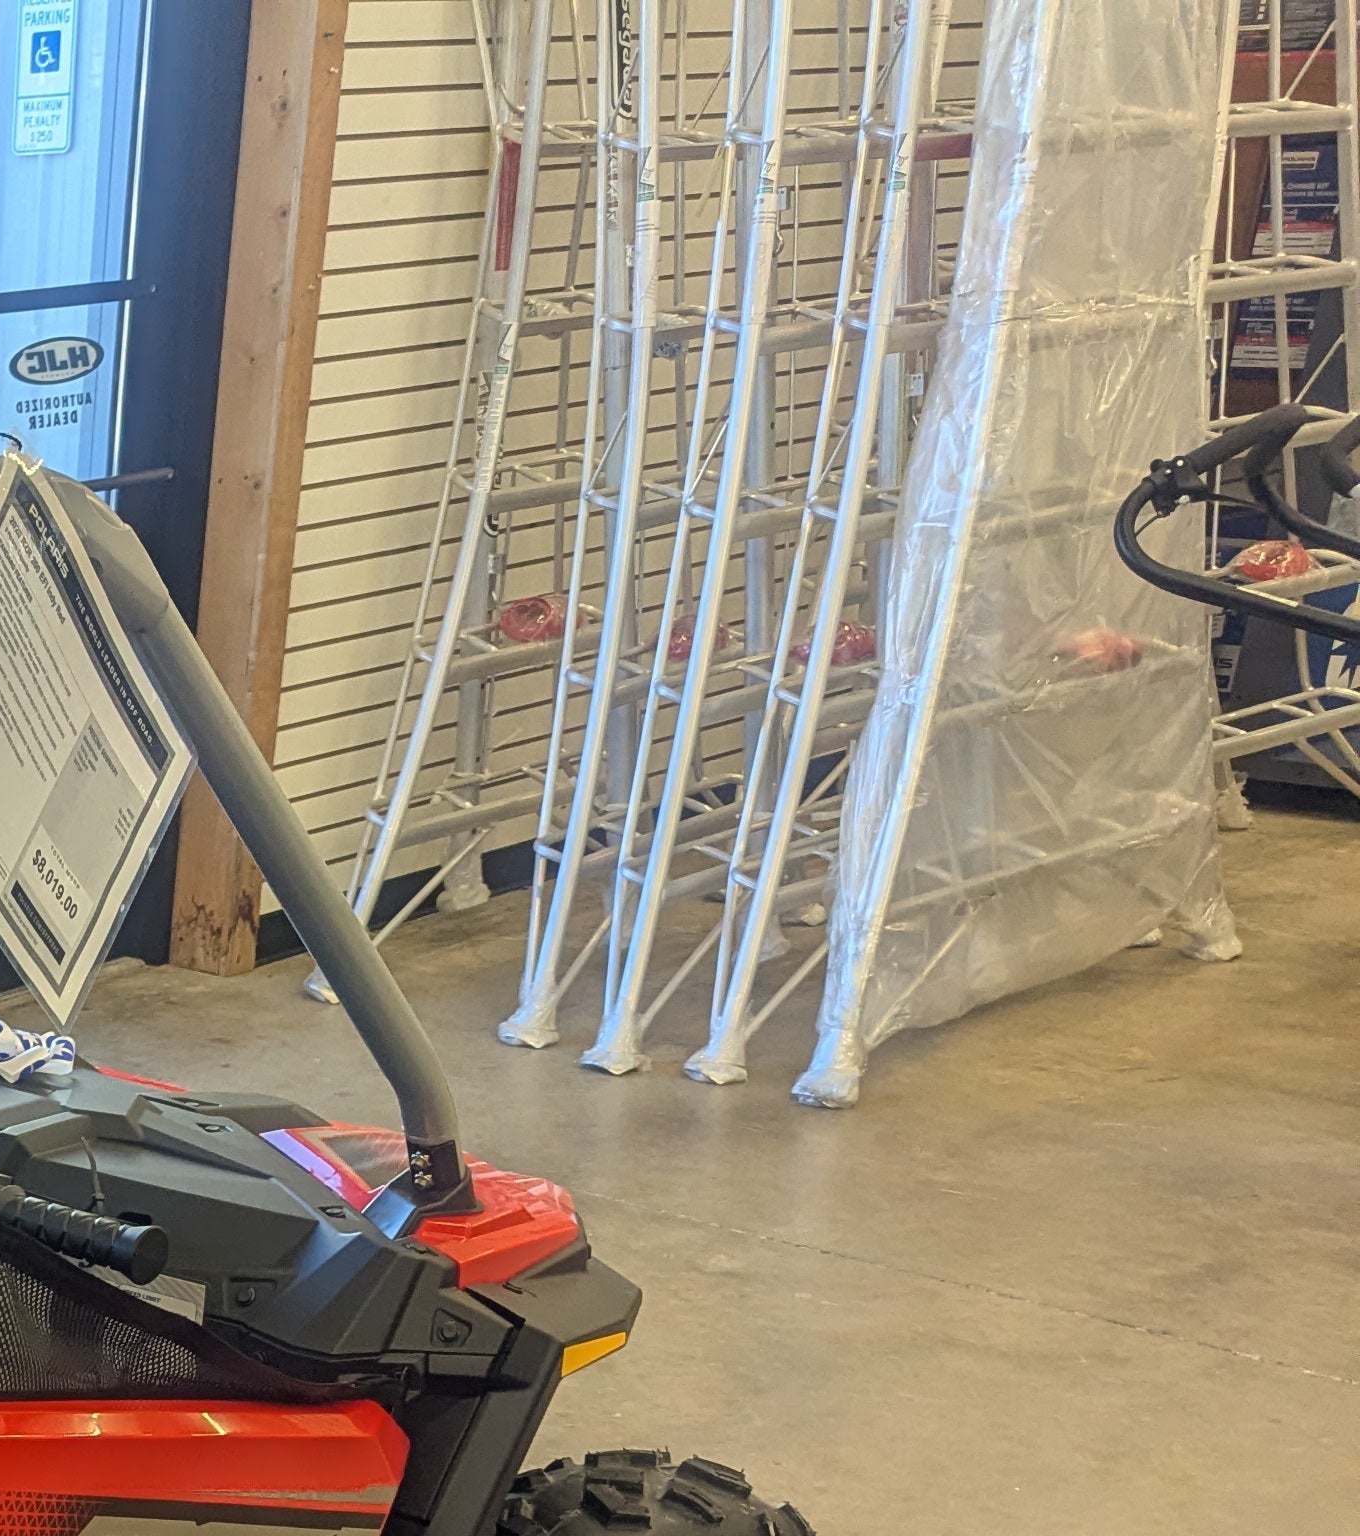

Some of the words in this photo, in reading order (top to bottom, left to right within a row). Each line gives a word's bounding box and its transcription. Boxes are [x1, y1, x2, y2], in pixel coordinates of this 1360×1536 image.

[24, 8, 70, 27] PARKING
[23, 100, 62, 112] MAXIMUM
[23, 114, 61, 128] PENALTY
[28, 502, 70, 579] POLARIS
[46, 586, 59, 608] Indy
[55, 604, 67, 625] Red
[32, 849, 78, 919] $8,019.00
